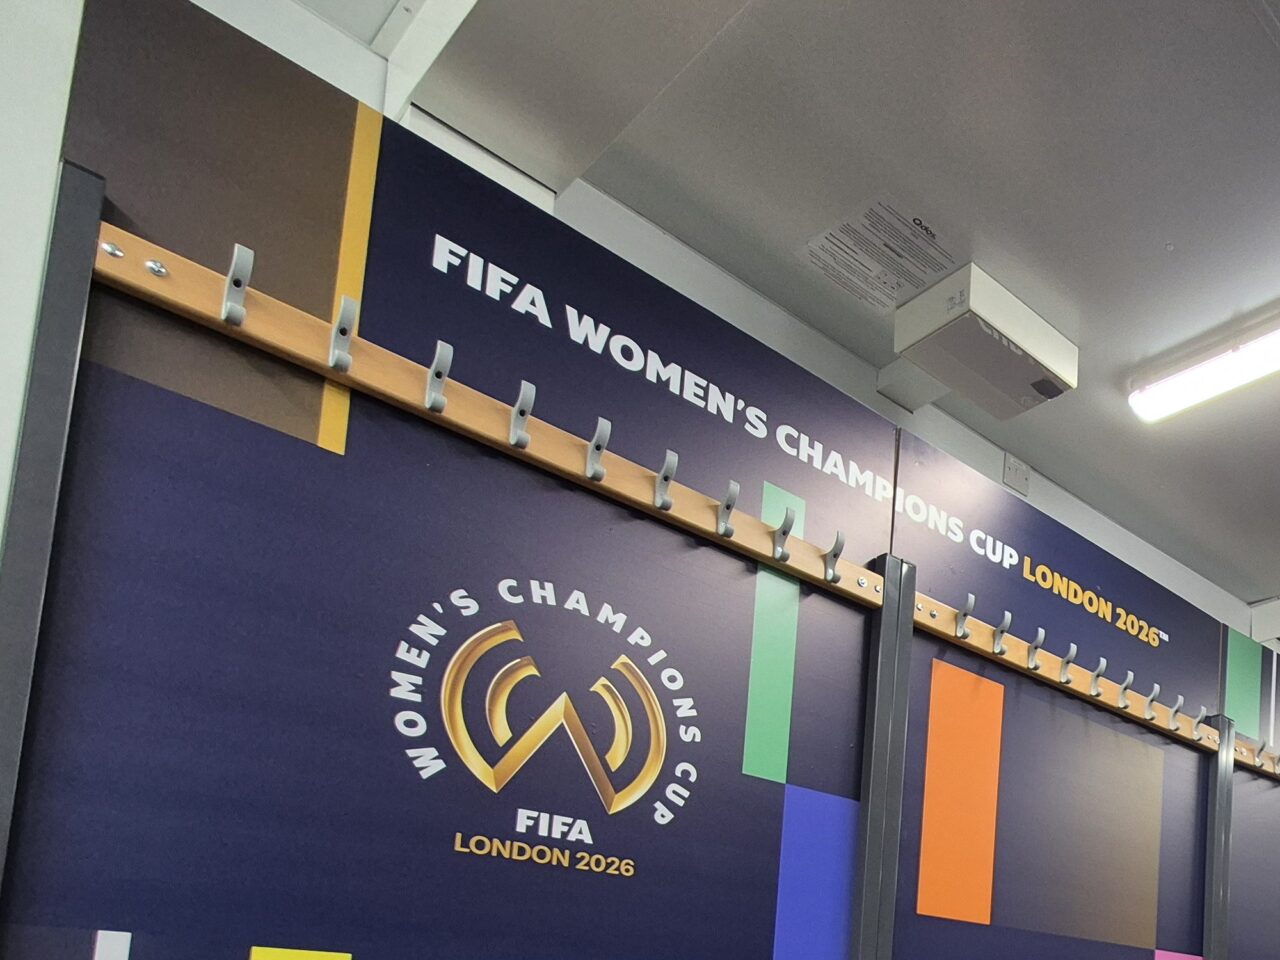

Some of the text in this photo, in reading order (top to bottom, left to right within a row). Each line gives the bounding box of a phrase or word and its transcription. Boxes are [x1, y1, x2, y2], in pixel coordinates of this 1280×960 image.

[432, 234, 553, 328] FIFA
[564, 304, 768, 440] WOMEN'S
[776, 424, 965, 545] CHAMPIONS
[969, 530, 1019, 570] CUP
[1023, 556, 1114, 625] LONDON
[389, 578, 702, 826] WOMEN'S CHAMPIONS CUP
[453, 832, 636, 878] LONDON 2026
[514, 808, 594, 845] FIFA
